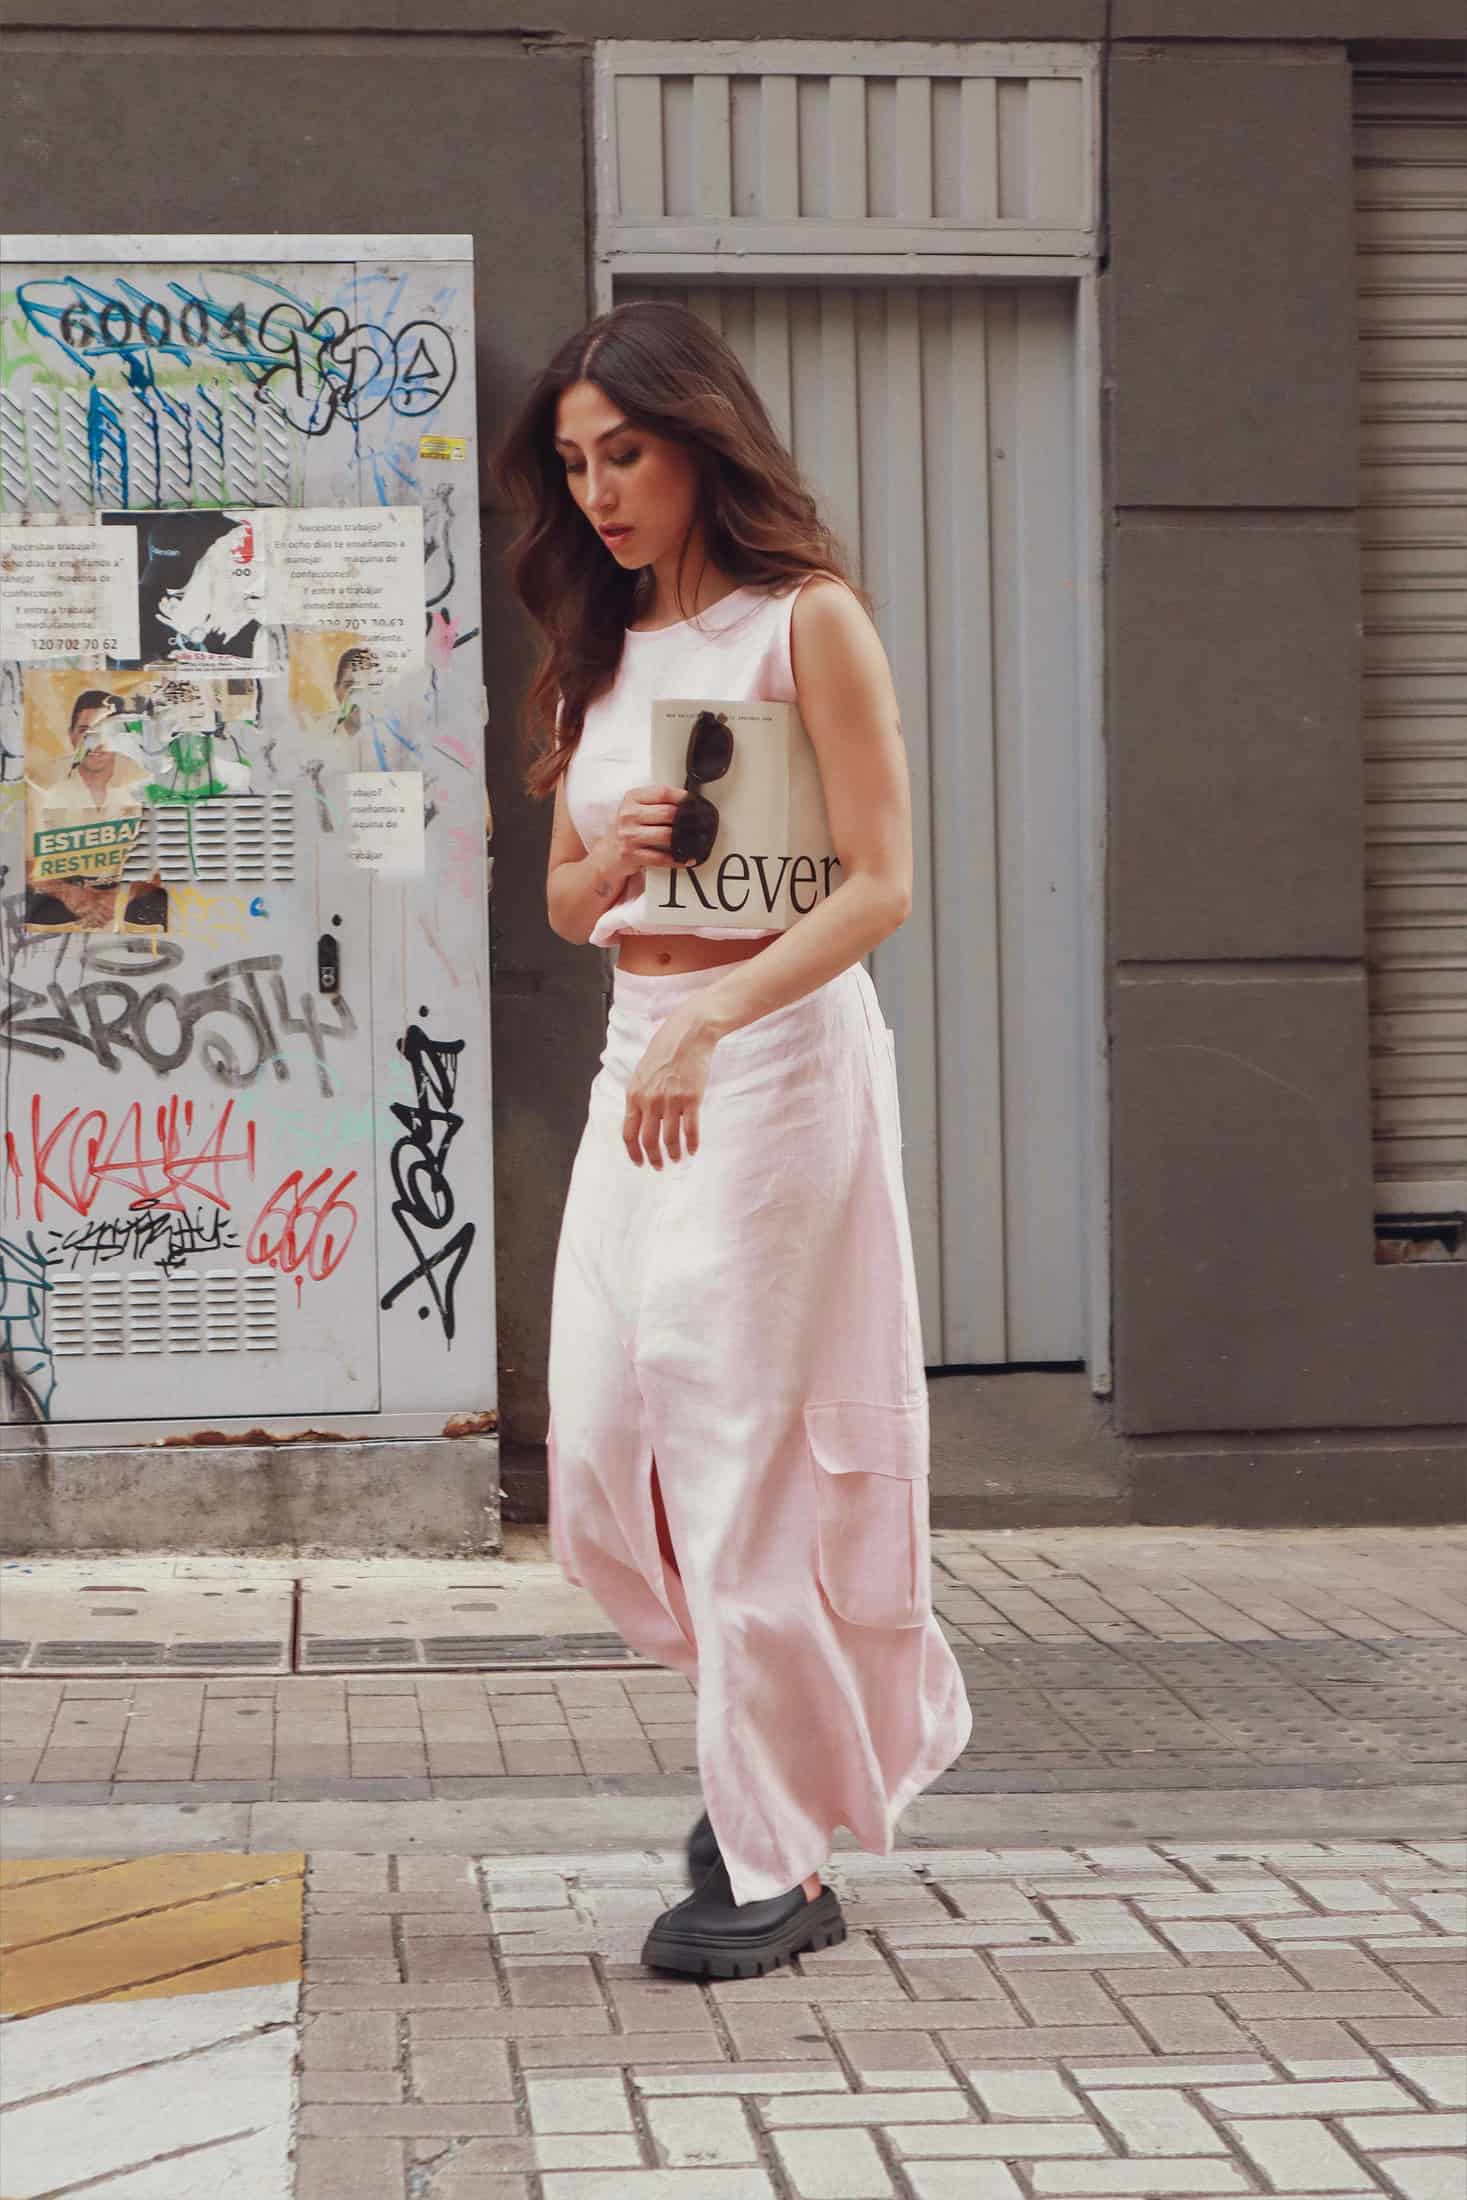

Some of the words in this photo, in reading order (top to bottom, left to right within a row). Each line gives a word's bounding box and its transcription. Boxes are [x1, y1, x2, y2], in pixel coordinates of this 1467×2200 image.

[60, 302, 248, 347] 60004
[83, 638, 99, 651] 70
[102, 638, 118, 651] 62
[40, 820, 140, 854] ESTEBA
